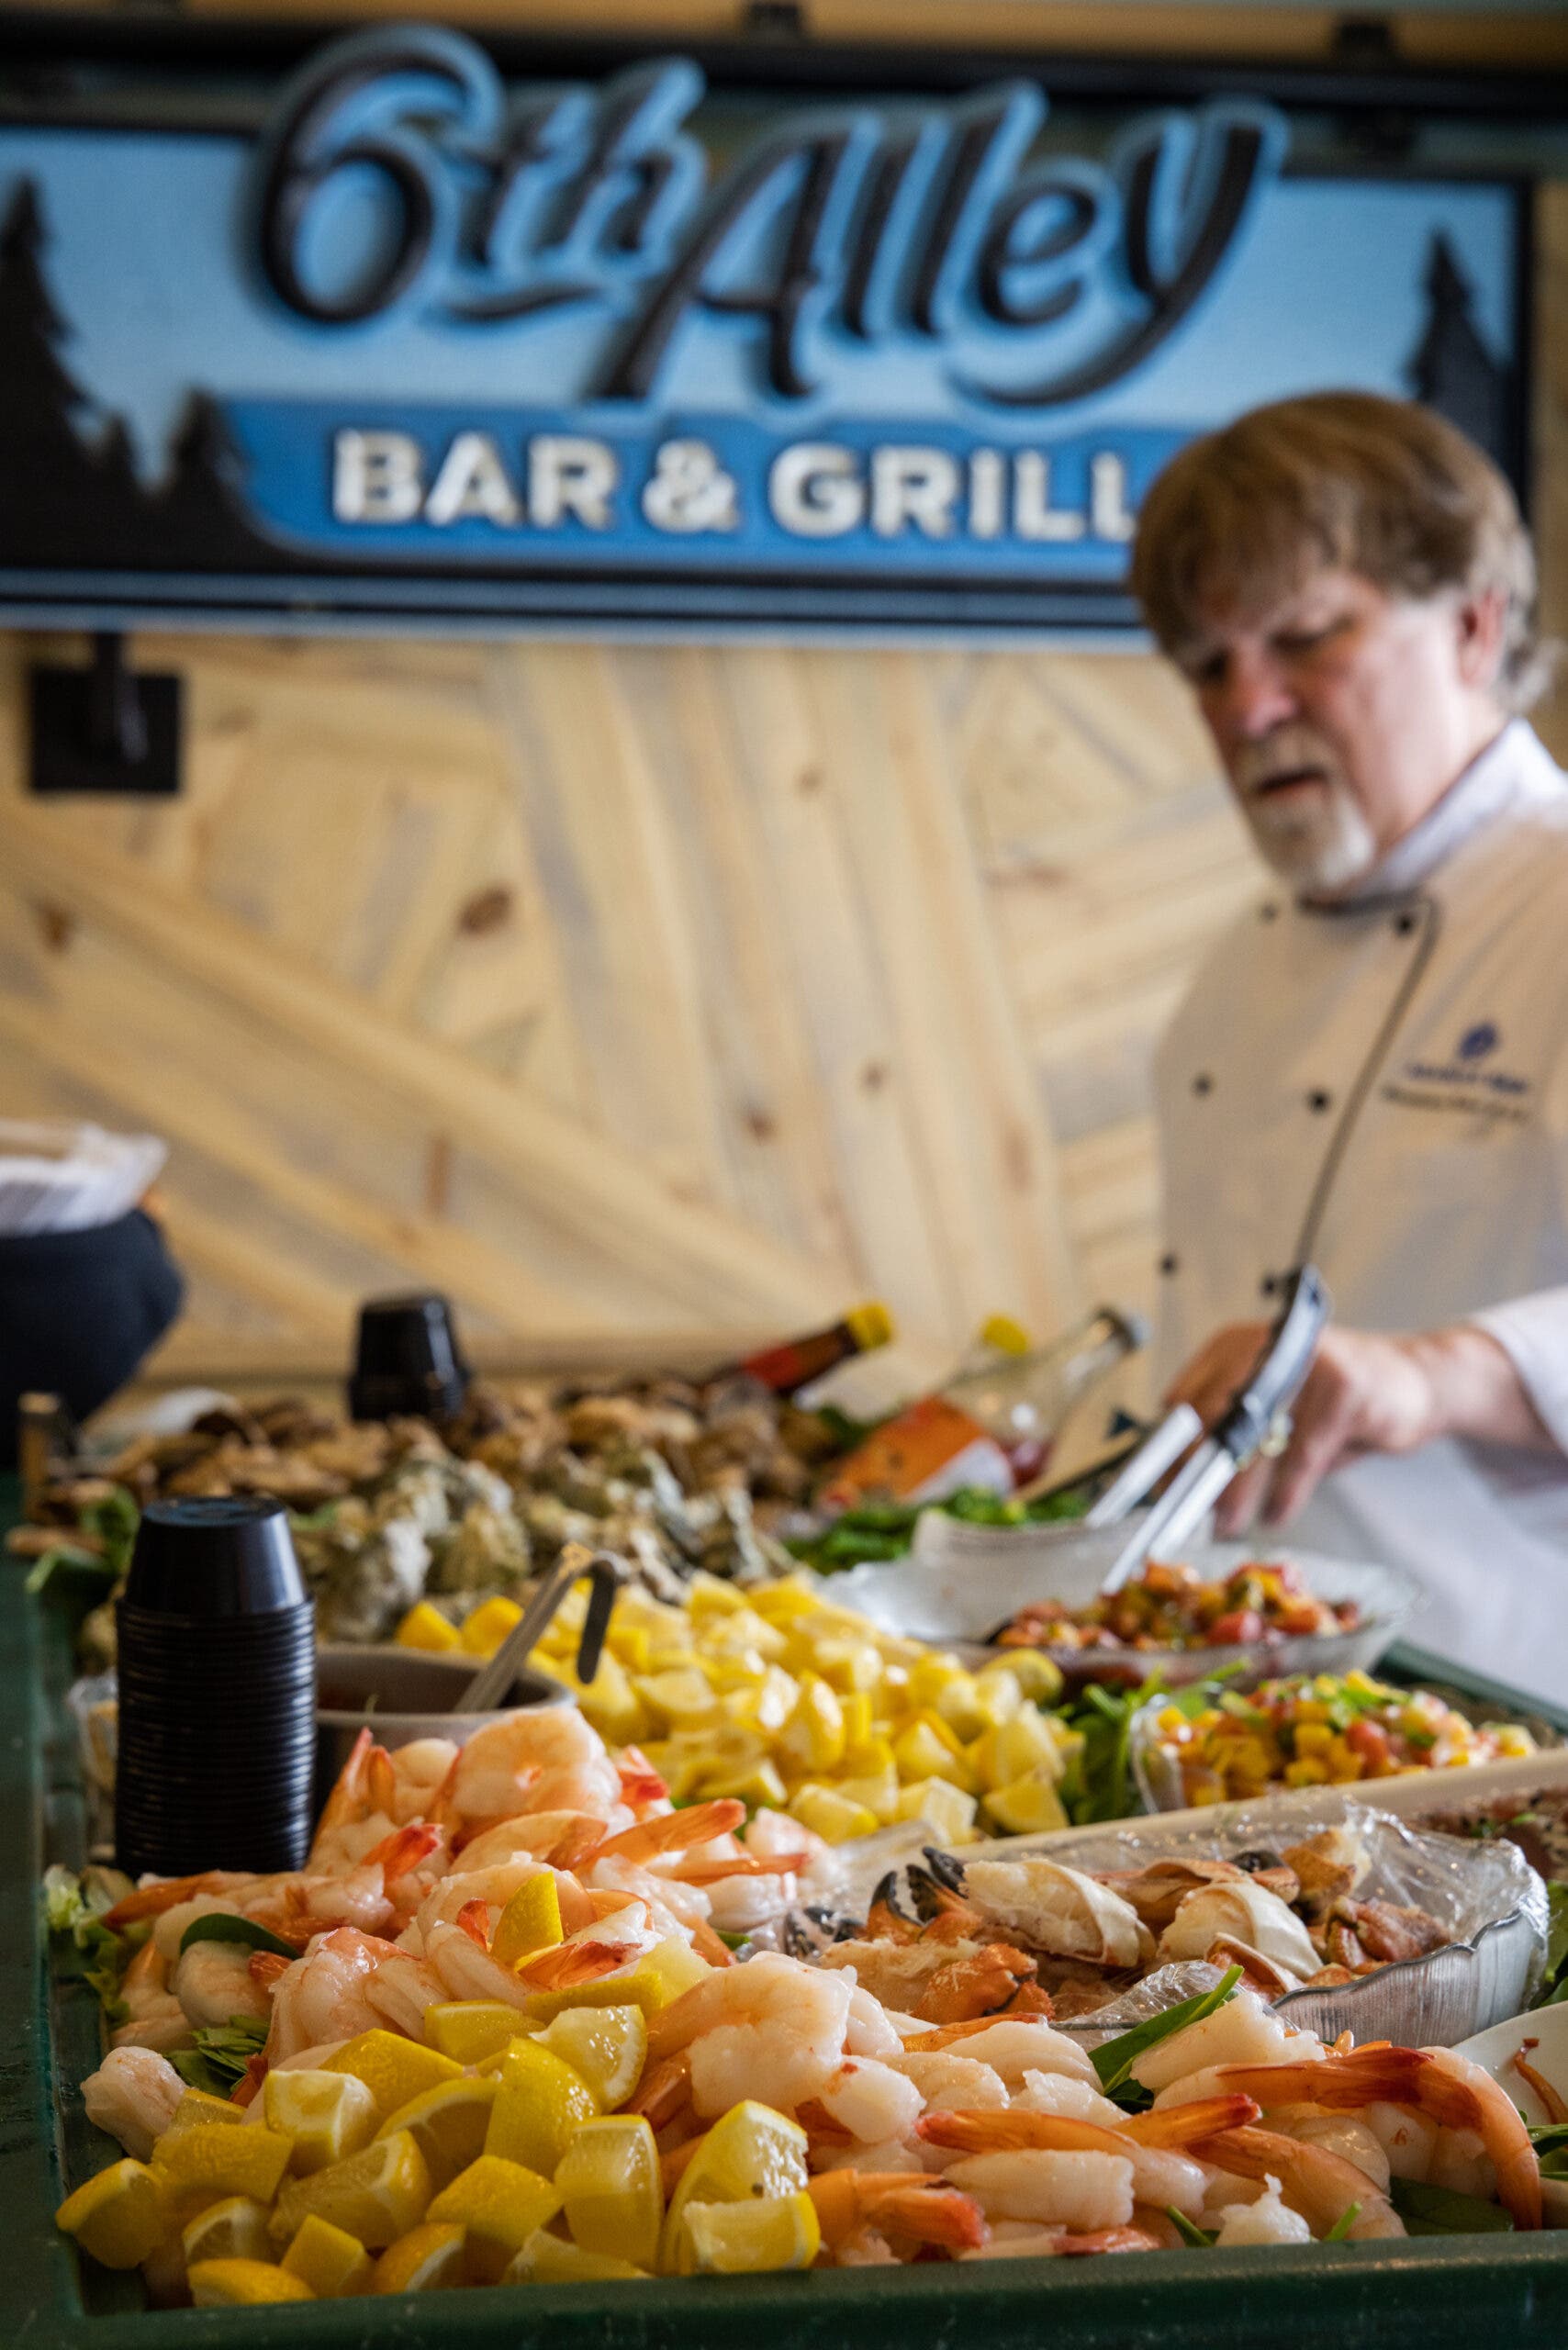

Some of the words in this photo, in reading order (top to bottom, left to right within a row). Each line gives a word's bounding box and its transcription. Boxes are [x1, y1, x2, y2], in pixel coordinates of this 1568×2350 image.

[250, 31, 703, 329] 6th
[577, 84, 1274, 418] Alley
[332, 428, 620, 529] BAR
[642, 442, 739, 533] &
[768, 442, 1137, 542] GRILL
